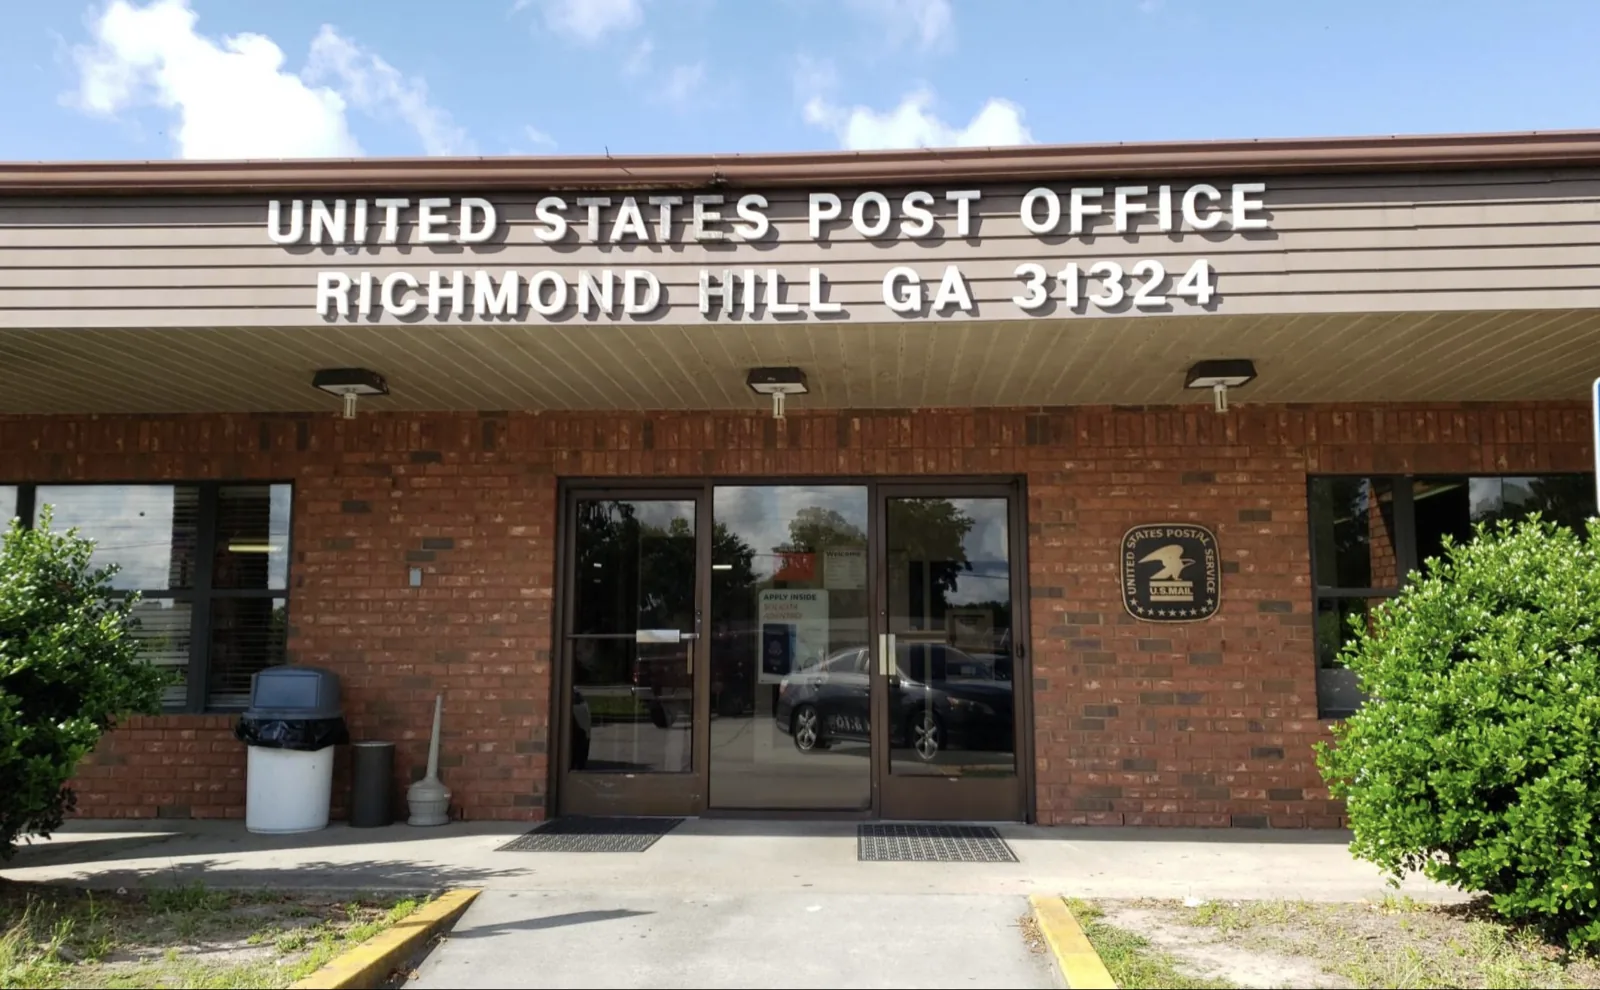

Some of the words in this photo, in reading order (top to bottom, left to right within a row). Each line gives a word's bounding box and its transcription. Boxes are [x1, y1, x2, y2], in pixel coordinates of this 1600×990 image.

[267, 198, 498, 245] UNITED
[533, 194, 770, 243] STATES
[808, 190, 981, 238] POST
[1020, 183, 1268, 234] OFFICE
[316, 269, 661, 317] RICHMOND
[699, 267, 842, 315] HILL
[882, 264, 974, 313] GA
[1012, 258, 1215, 310] 31324
[1126, 529, 1163, 549] STATES
[1166, 529, 1210, 547] POSTAL
[1126, 551, 1137, 595] UNITED
[1204, 548, 1216, 594] SERVICE
[763, 593, 788, 601] APPLY
[790, 593, 817, 601] INSIDE
